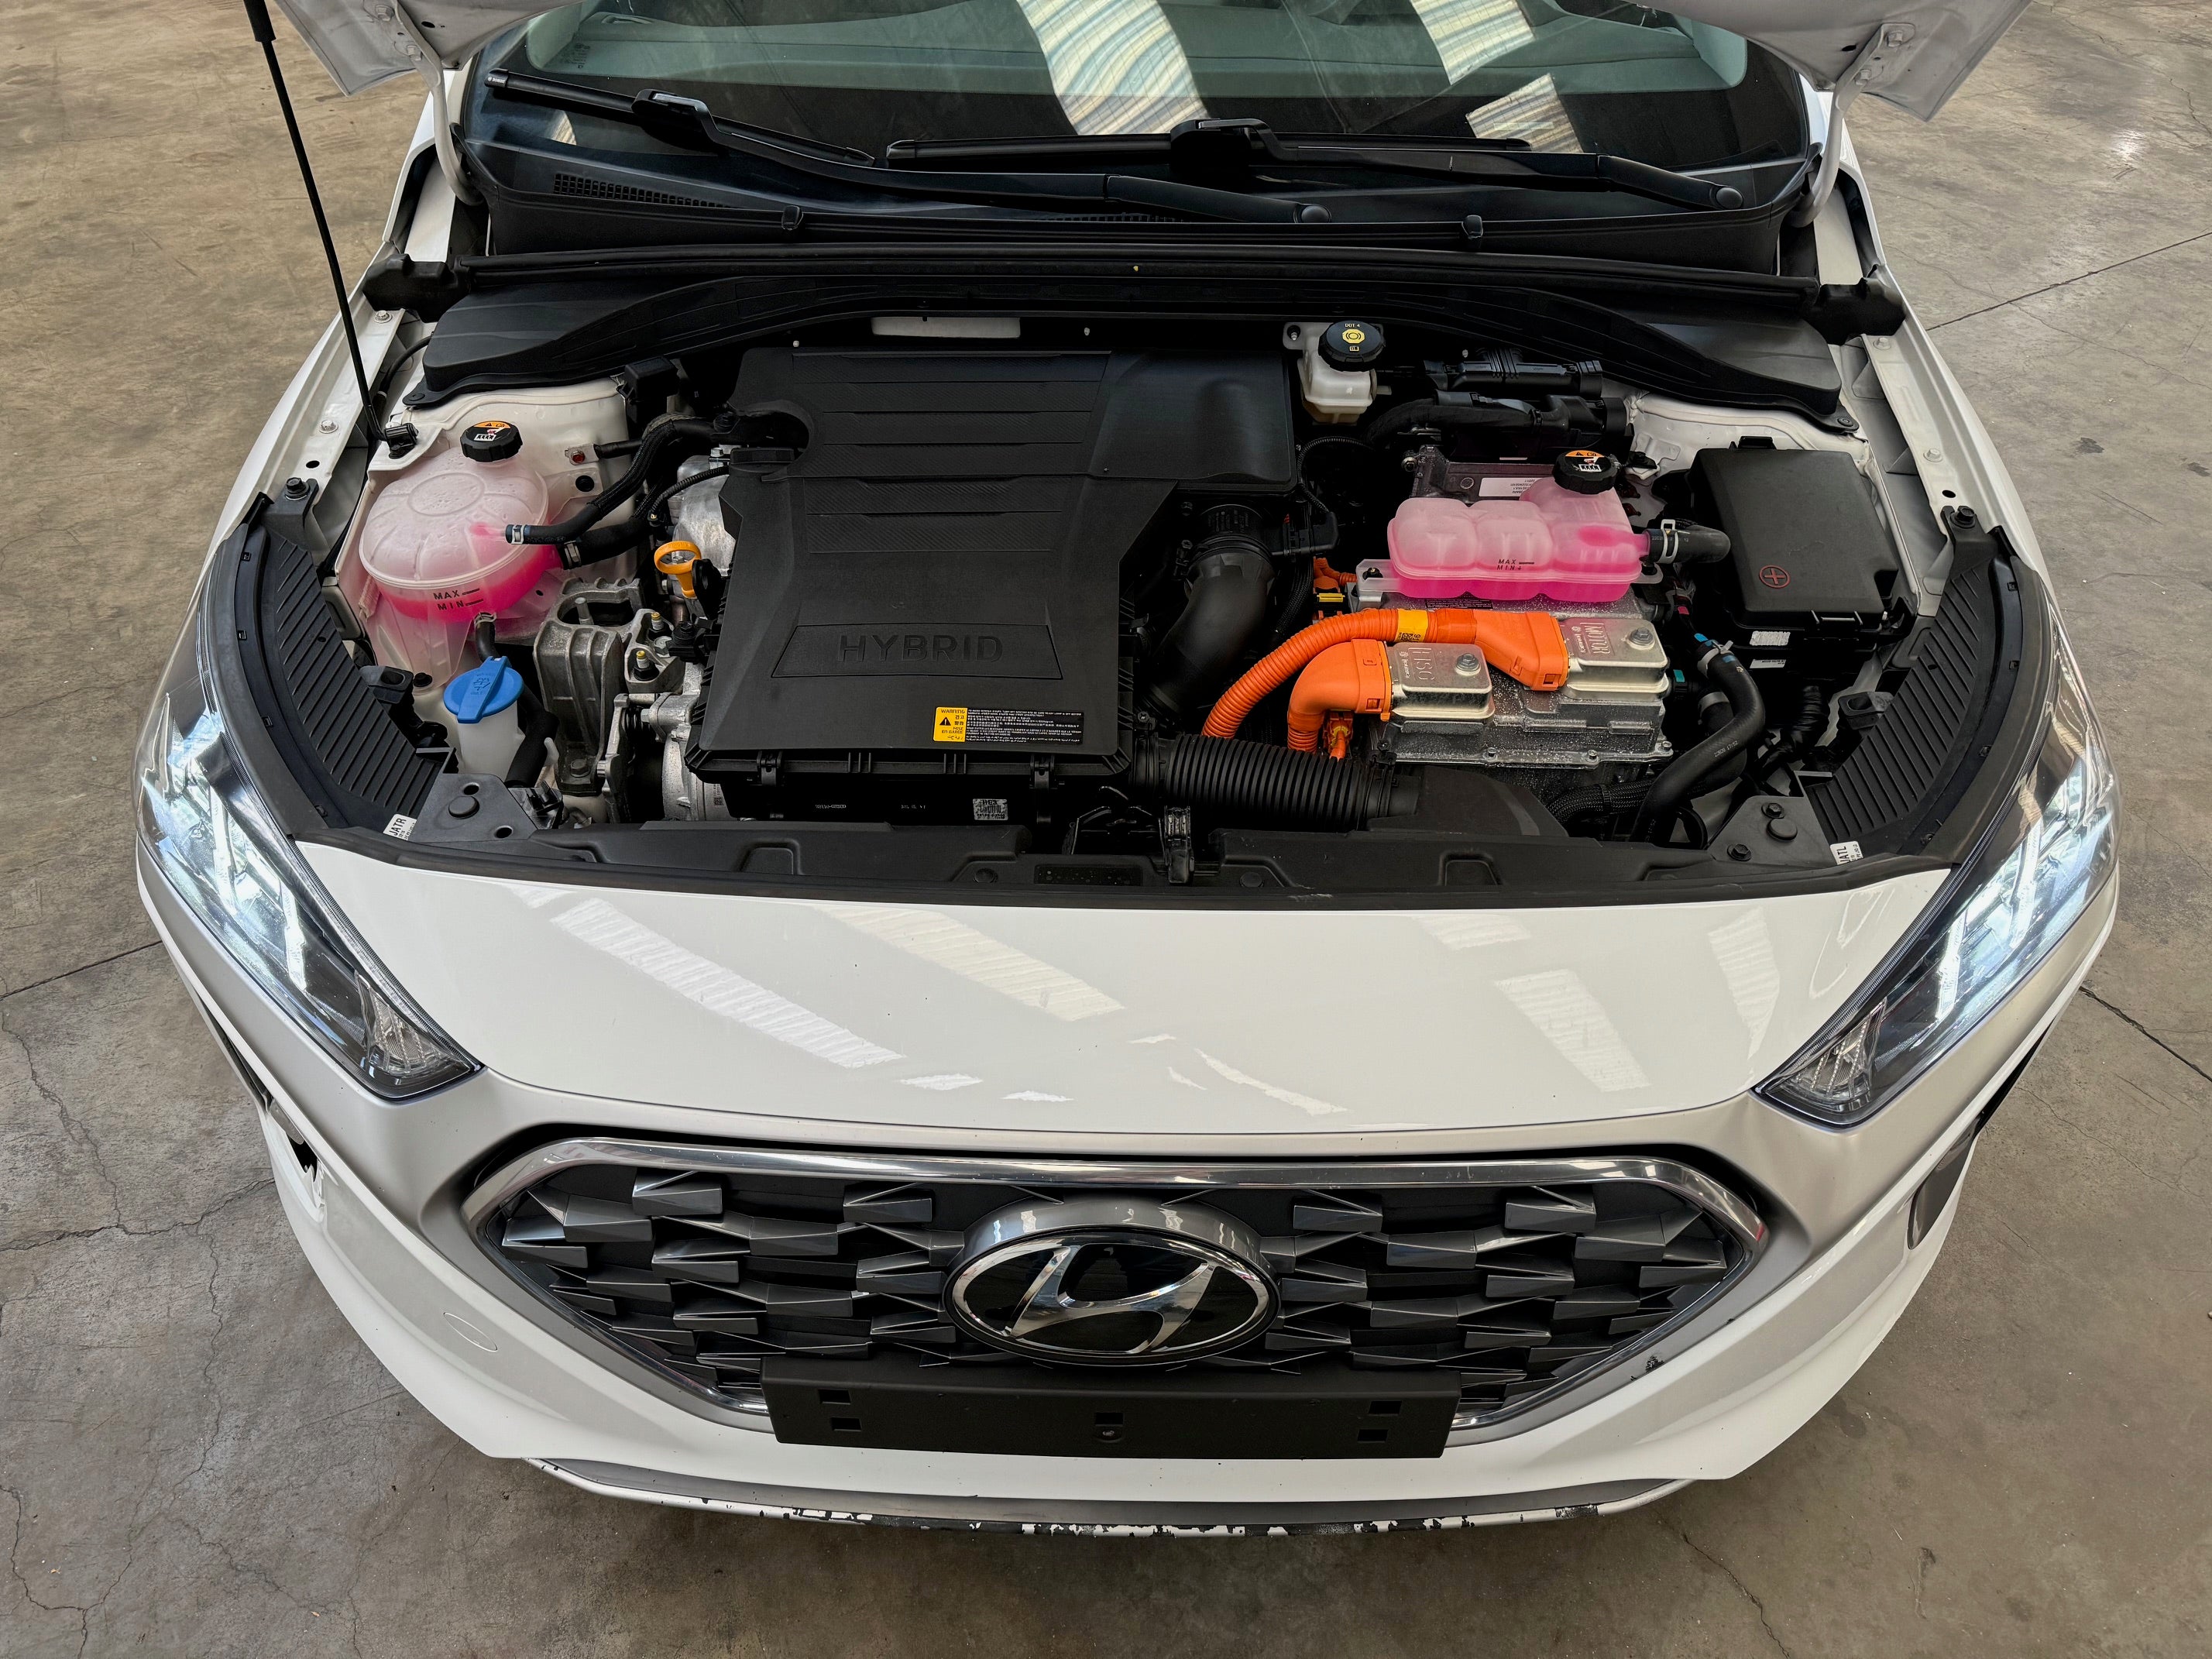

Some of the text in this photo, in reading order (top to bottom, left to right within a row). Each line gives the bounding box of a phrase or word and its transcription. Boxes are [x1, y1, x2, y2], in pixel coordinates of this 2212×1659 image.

[433, 589, 460, 600] MAX
[437, 600, 465, 610] MIN
[838, 634, 1004, 663] HYBRID
[1584, 625, 1611, 654] MOTOR
[389, 818, 407, 836] JATR
